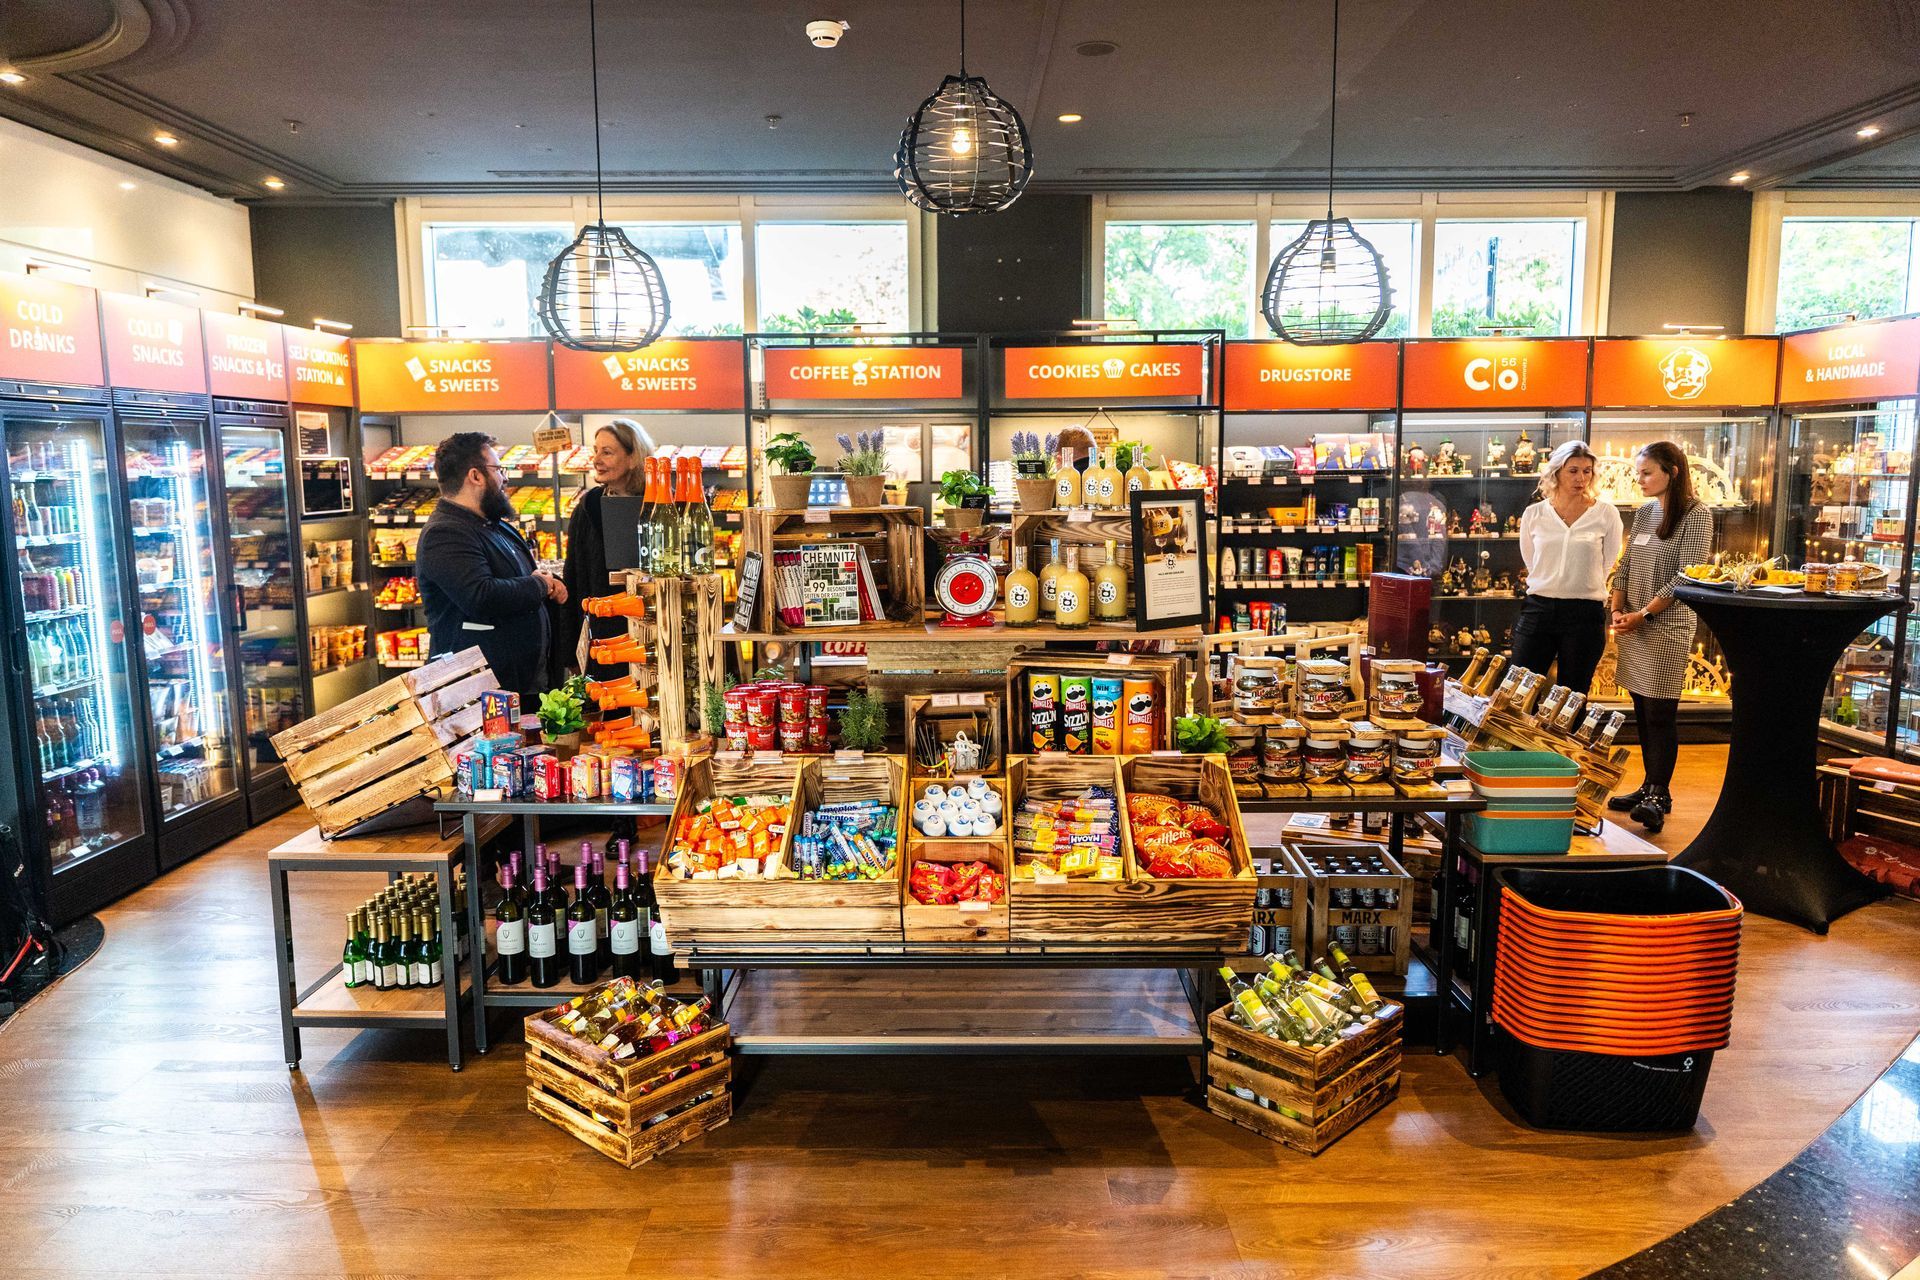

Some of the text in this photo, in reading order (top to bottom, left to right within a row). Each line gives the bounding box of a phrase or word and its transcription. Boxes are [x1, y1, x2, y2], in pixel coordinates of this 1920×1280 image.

[17, 299, 63, 325] COLD
[128, 318, 163, 338] COLD
[226, 334, 268, 355] FROZEN
[132, 344, 184, 367] SNACKS
[290, 344, 311, 361] SELF
[1828, 344, 1866, 361] LOCAL
[212, 355, 256, 376] SNACKS
[256, 361, 265, 376] &
[430, 359, 492, 373] SNACKS
[627, 358, 689, 372] SNACKS
[1501, 357, 1517, 367] 56
[297, 367, 333, 384] STATION
[789, 364, 941, 380] COFFEE STATION
[1029, 363, 1101, 379] COOKIES
[1130, 362, 1181, 377] CAKES
[1260, 367, 1352, 383] DRUGSTORE
[1464, 358, 1492, 392] C
[1805, 361, 1885, 383] & HANDMADE
[424, 379, 499, 392] & SWEETS
[621, 378, 697, 391] & SWEETS
[803, 551, 856, 563] CHEMNITZ
[812, 581, 826, 593] 99
[1033, 699, 1053, 709] PRINGLES
[1065, 701, 1087, 711] PRINGLES
[1032, 710, 1056, 725] SIZZL'N
[1064, 711, 1089, 727] SIZZL'N
[1093, 717, 1114, 729] PRINGLES
[1129, 713, 1152, 725] PRINGLES
[823, 803, 858, 813] mentos
[820, 813, 855, 821] mentos
[1070, 834, 1100, 843] MAOAM
[1342, 911, 1381, 924] MARX
